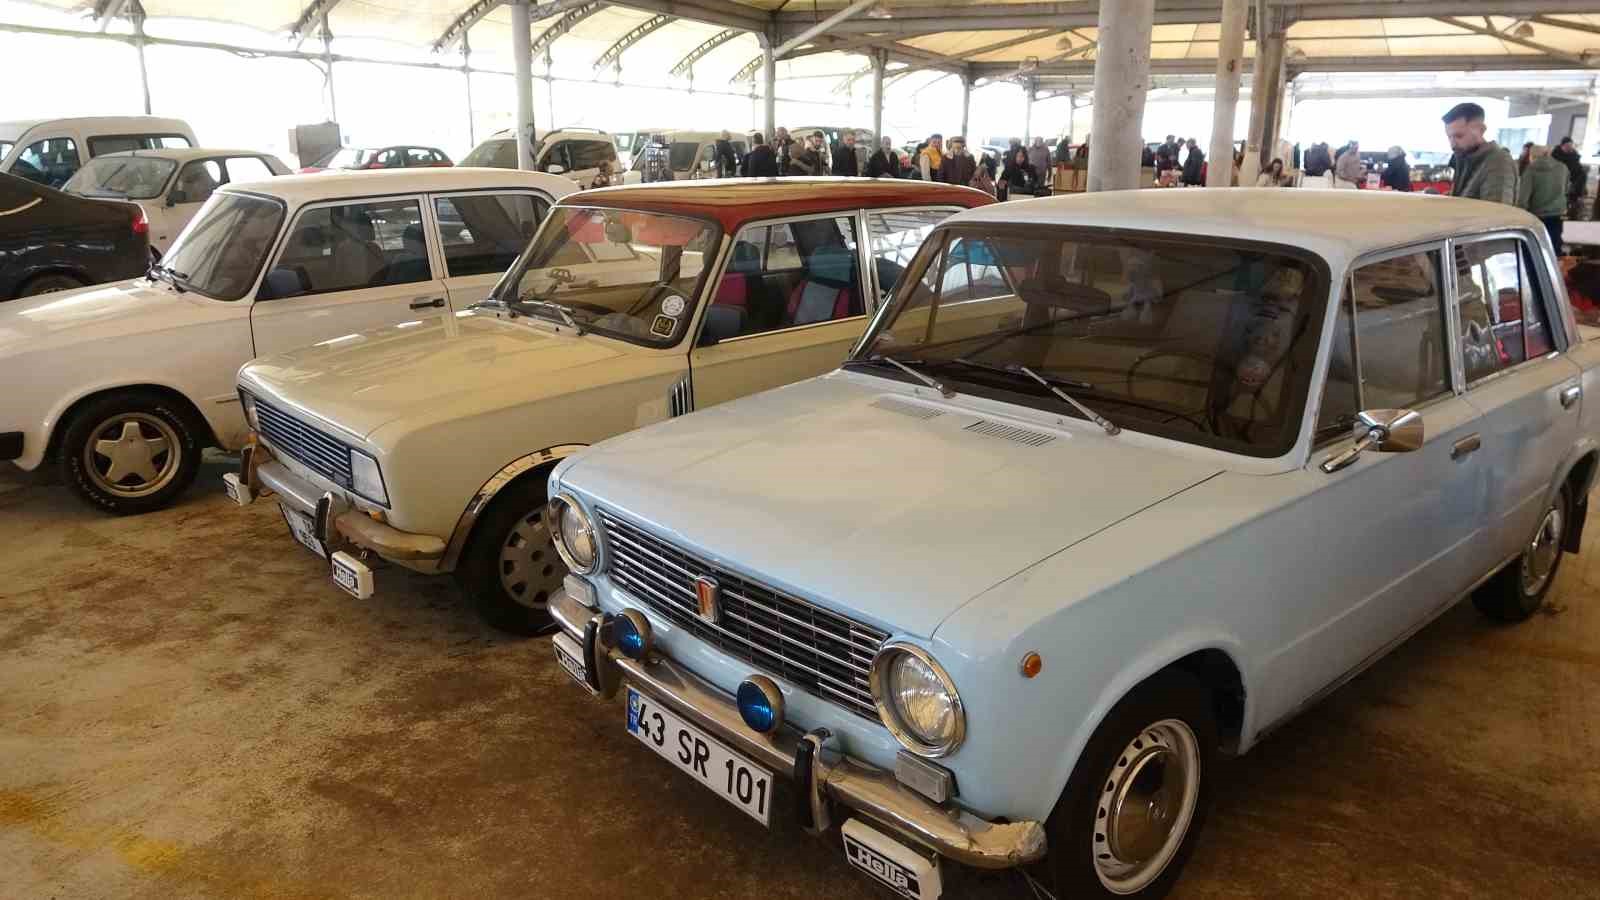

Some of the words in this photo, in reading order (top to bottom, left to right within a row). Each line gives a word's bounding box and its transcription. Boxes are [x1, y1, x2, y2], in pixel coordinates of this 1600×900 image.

[638, 704, 666, 746] 43
[678, 729, 710, 778] SR
[725, 759, 767, 815] 101
[858, 847, 909, 889] Hella
